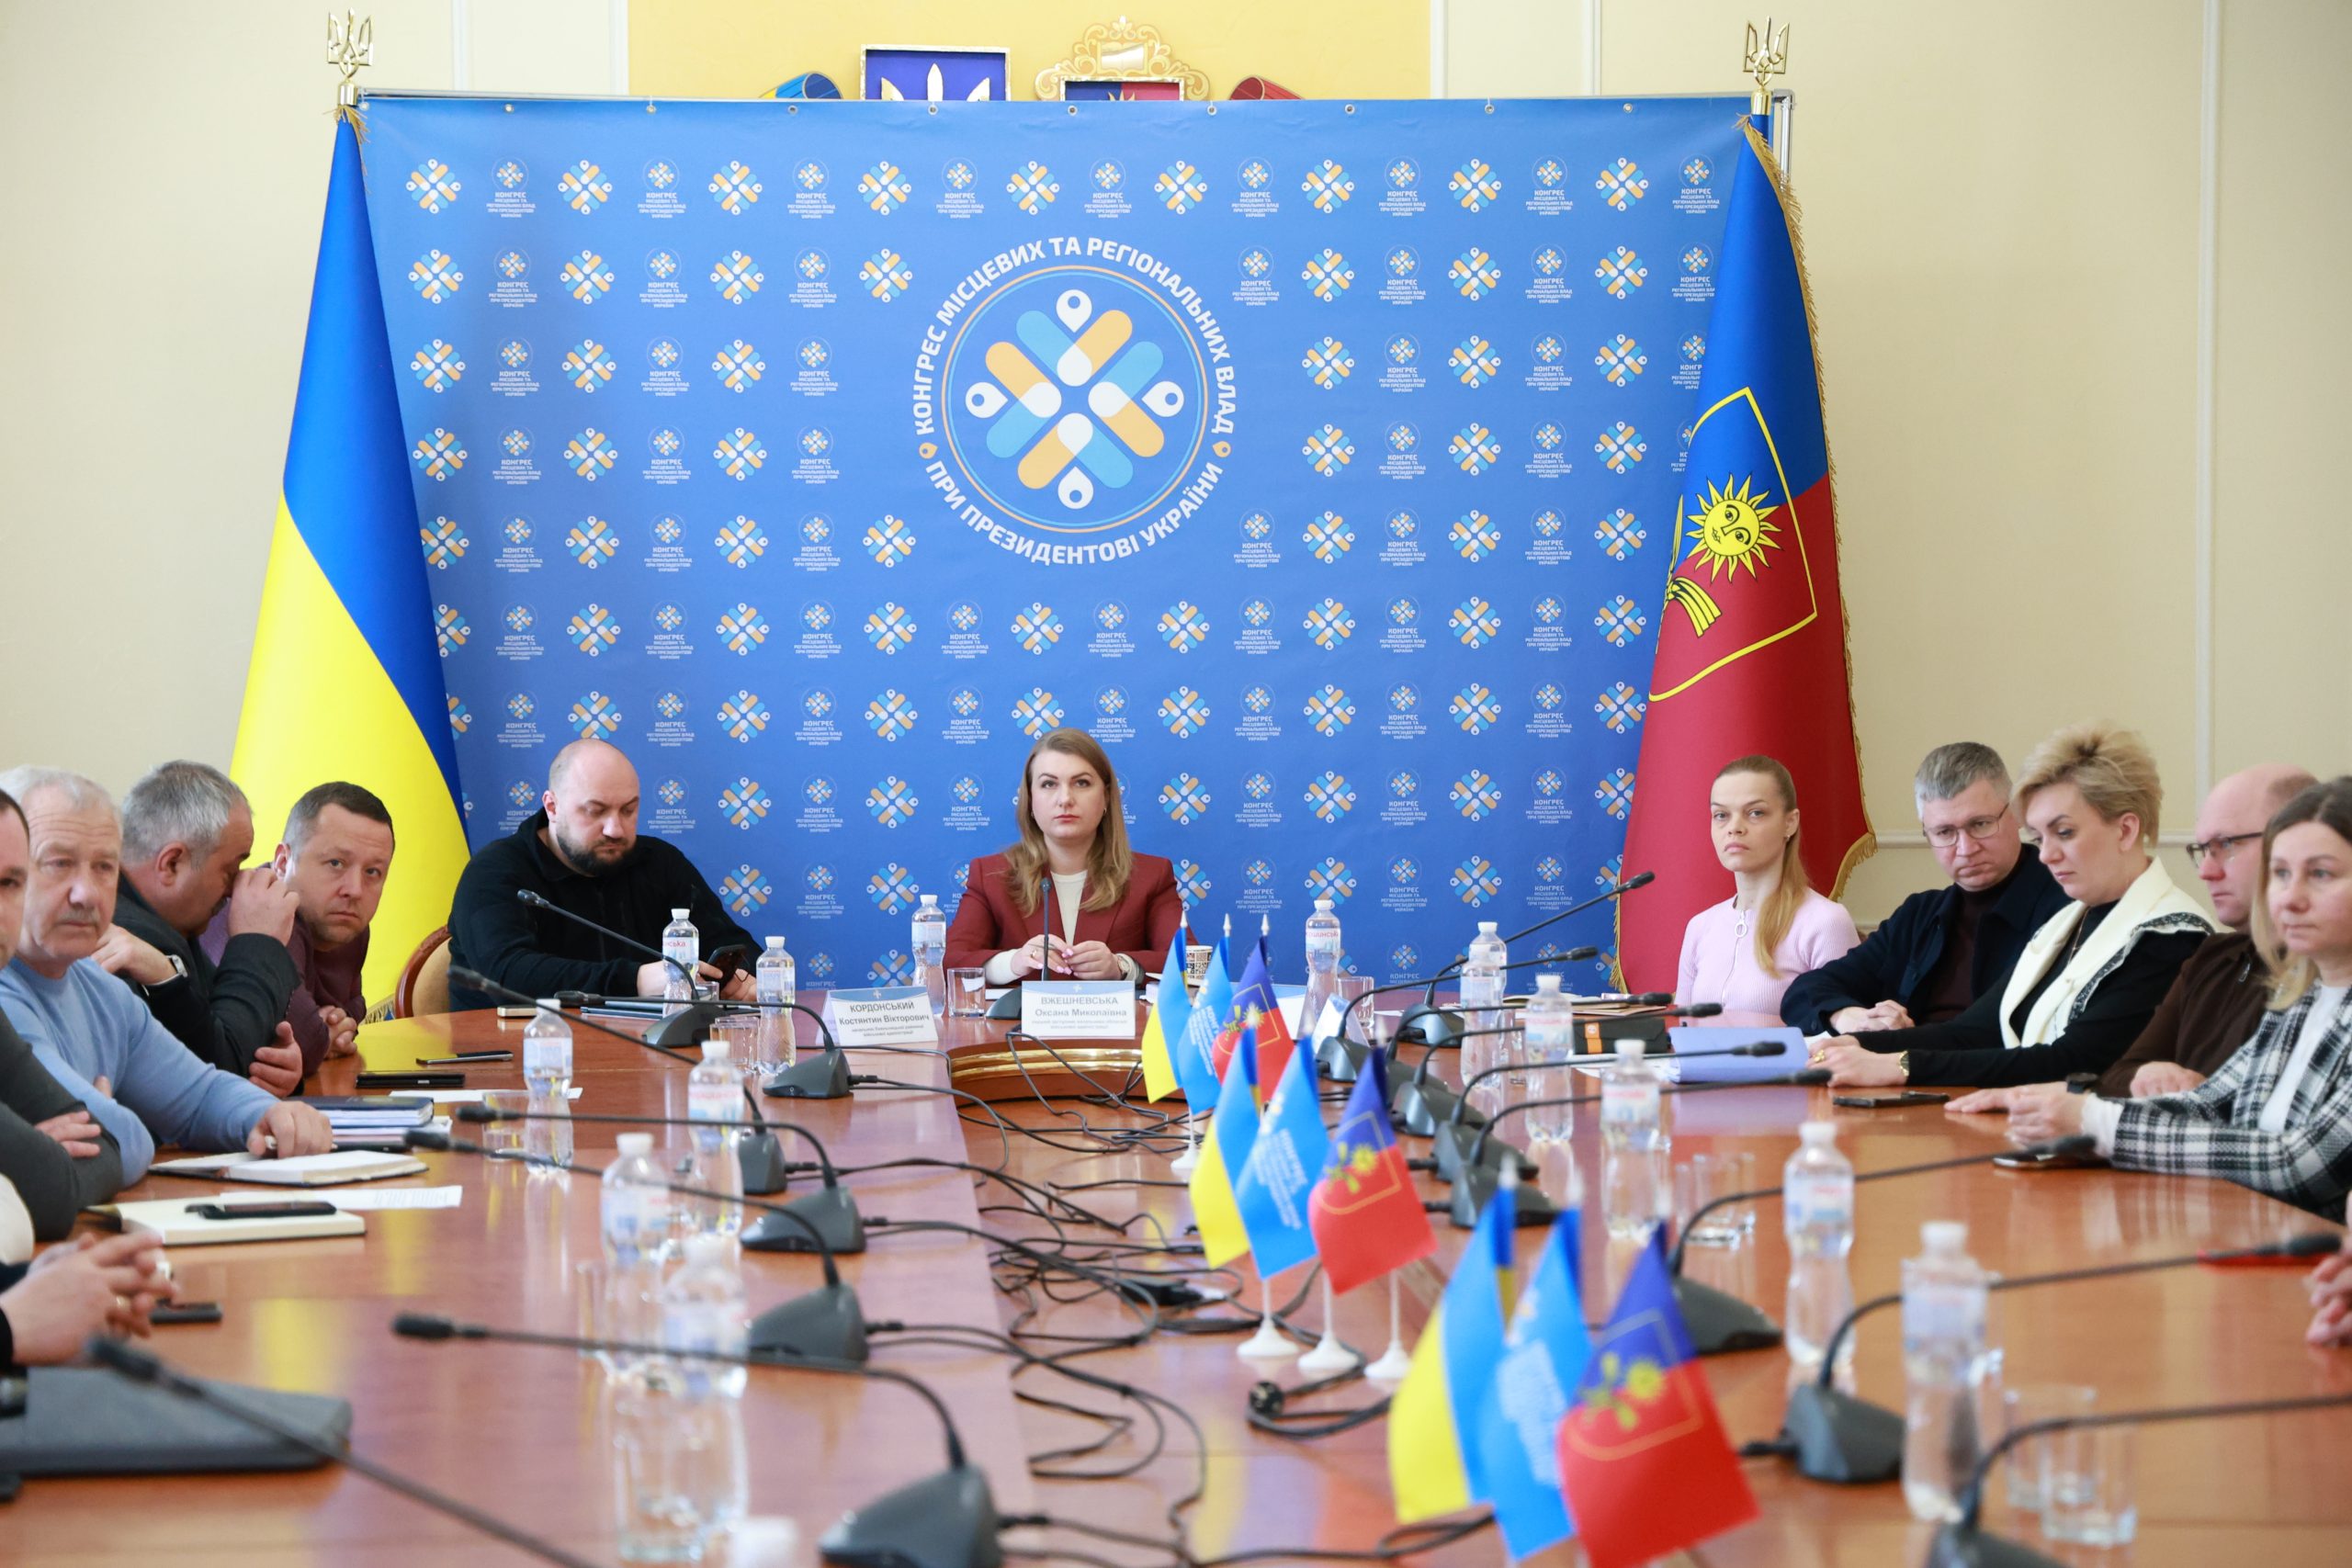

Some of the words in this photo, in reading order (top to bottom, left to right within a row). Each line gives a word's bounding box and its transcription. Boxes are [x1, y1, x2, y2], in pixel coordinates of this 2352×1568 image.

[912, 325, 947, 435] КОНГРЕС
[937, 240, 1046, 327] МІСЦЕВИХ
[1048, 236, 1081, 256] ТА
[1087, 237, 1231, 364] РЕГІОНАЛЬНИХ
[1211, 366, 1237, 434] ВЛАД
[925, 461, 965, 511] ПРИ
[960, 505, 1140, 566] ПРЕЗИДЕНТОВІ
[1138, 463, 1223, 547] УКРАЇНИ
[850, 1001, 915, 1012] КОРДОНСЬКИЙ
[1041, 997, 1118, 1005] ВЖЕШНЕВСЬКА
[1035, 1009, 1069, 1017] Оксана
[1071, 1009, 1126, 1017] Миколаївна
[839, 1017, 882, 1025] Костянтин
[884, 1014, 930, 1023] Вікторович
